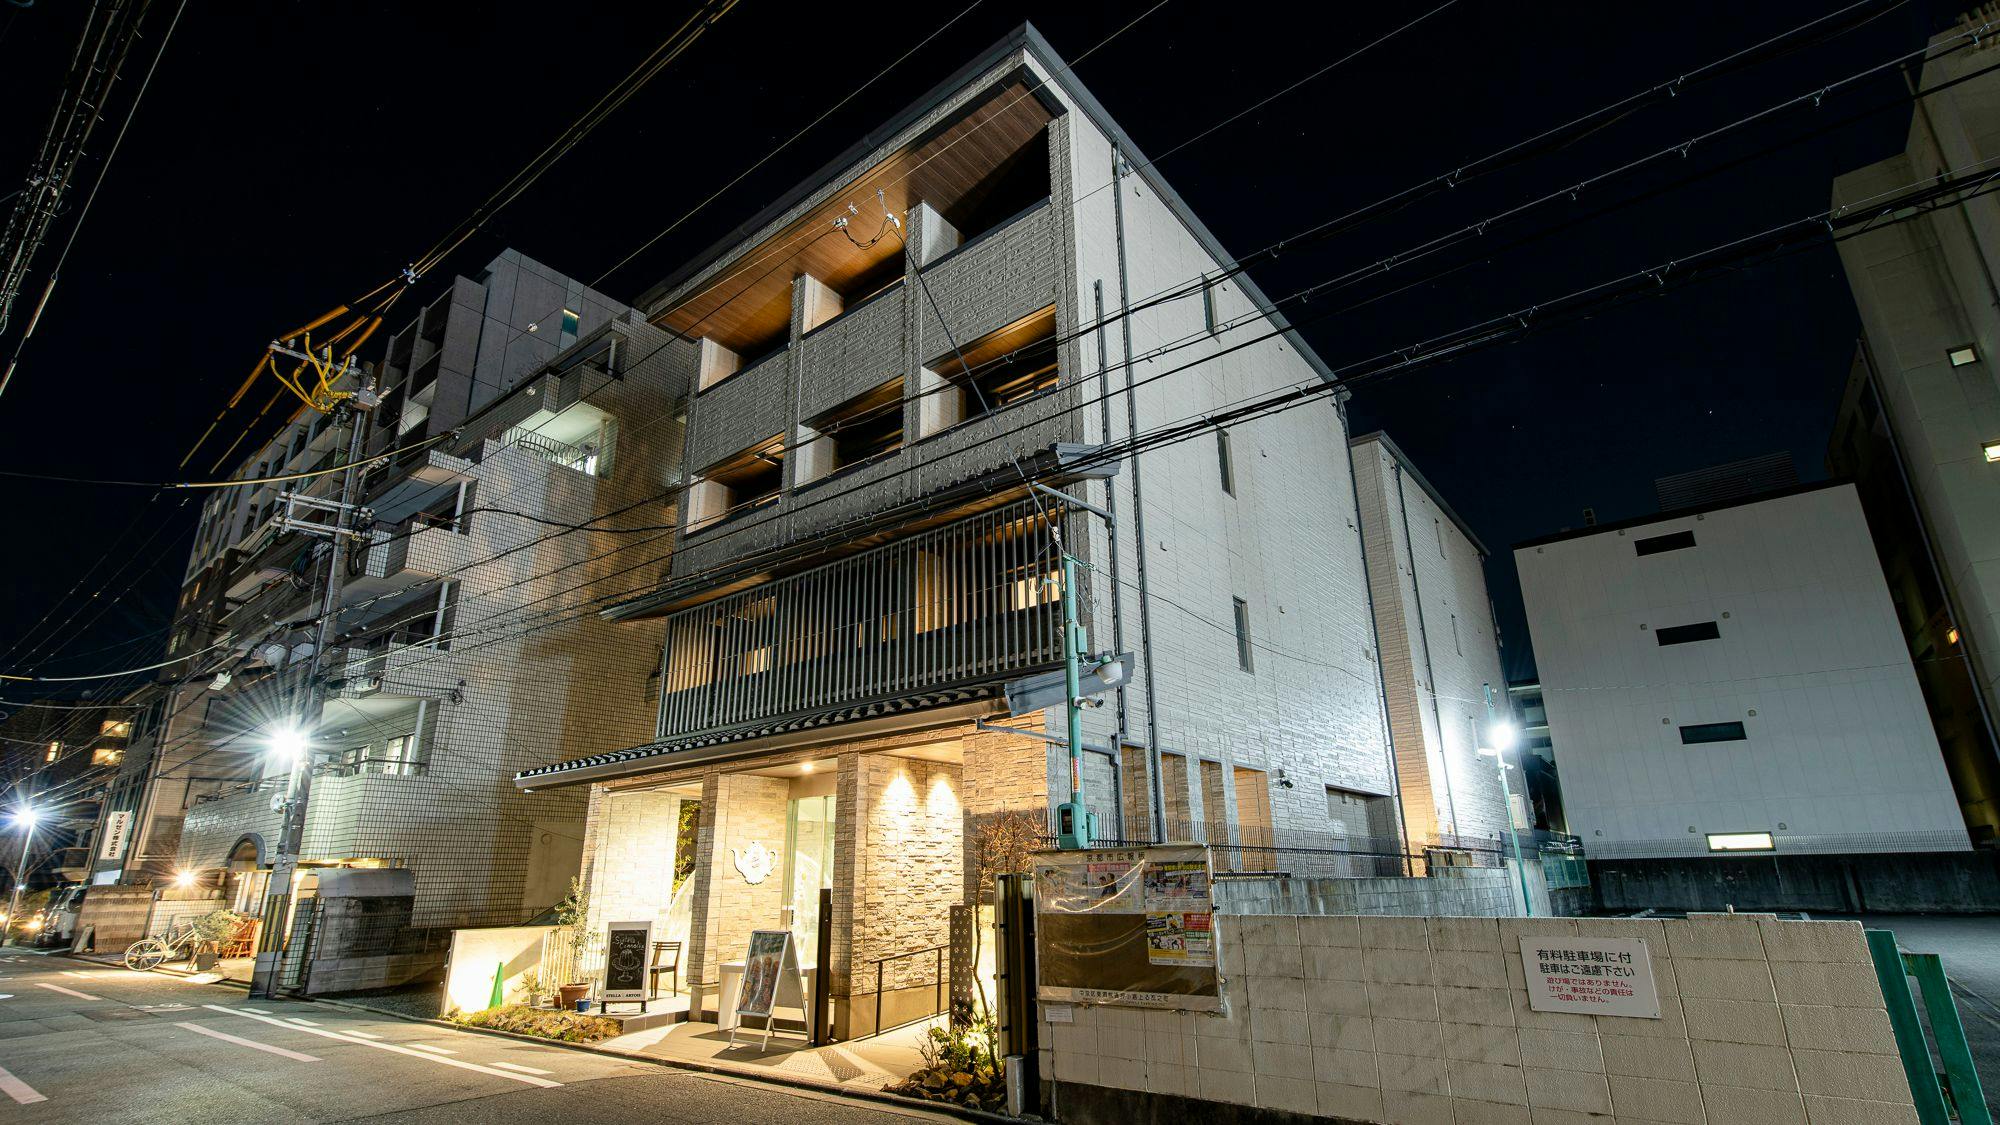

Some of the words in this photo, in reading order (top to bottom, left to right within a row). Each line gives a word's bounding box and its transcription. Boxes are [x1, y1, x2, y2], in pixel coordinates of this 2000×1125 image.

[1086, 851, 1145, 862] 京都市広報板
[1536, 949, 1632, 964] 有料駐車場に付
[1540, 963, 1635, 977] 駐車はご遠慮下さい
[1546, 976, 1633, 988] 遊び場ではありません。
[1549, 986, 1634, 997] けが・事故などの責任は
[1550, 994, 1610, 1003] 一切負いません。
